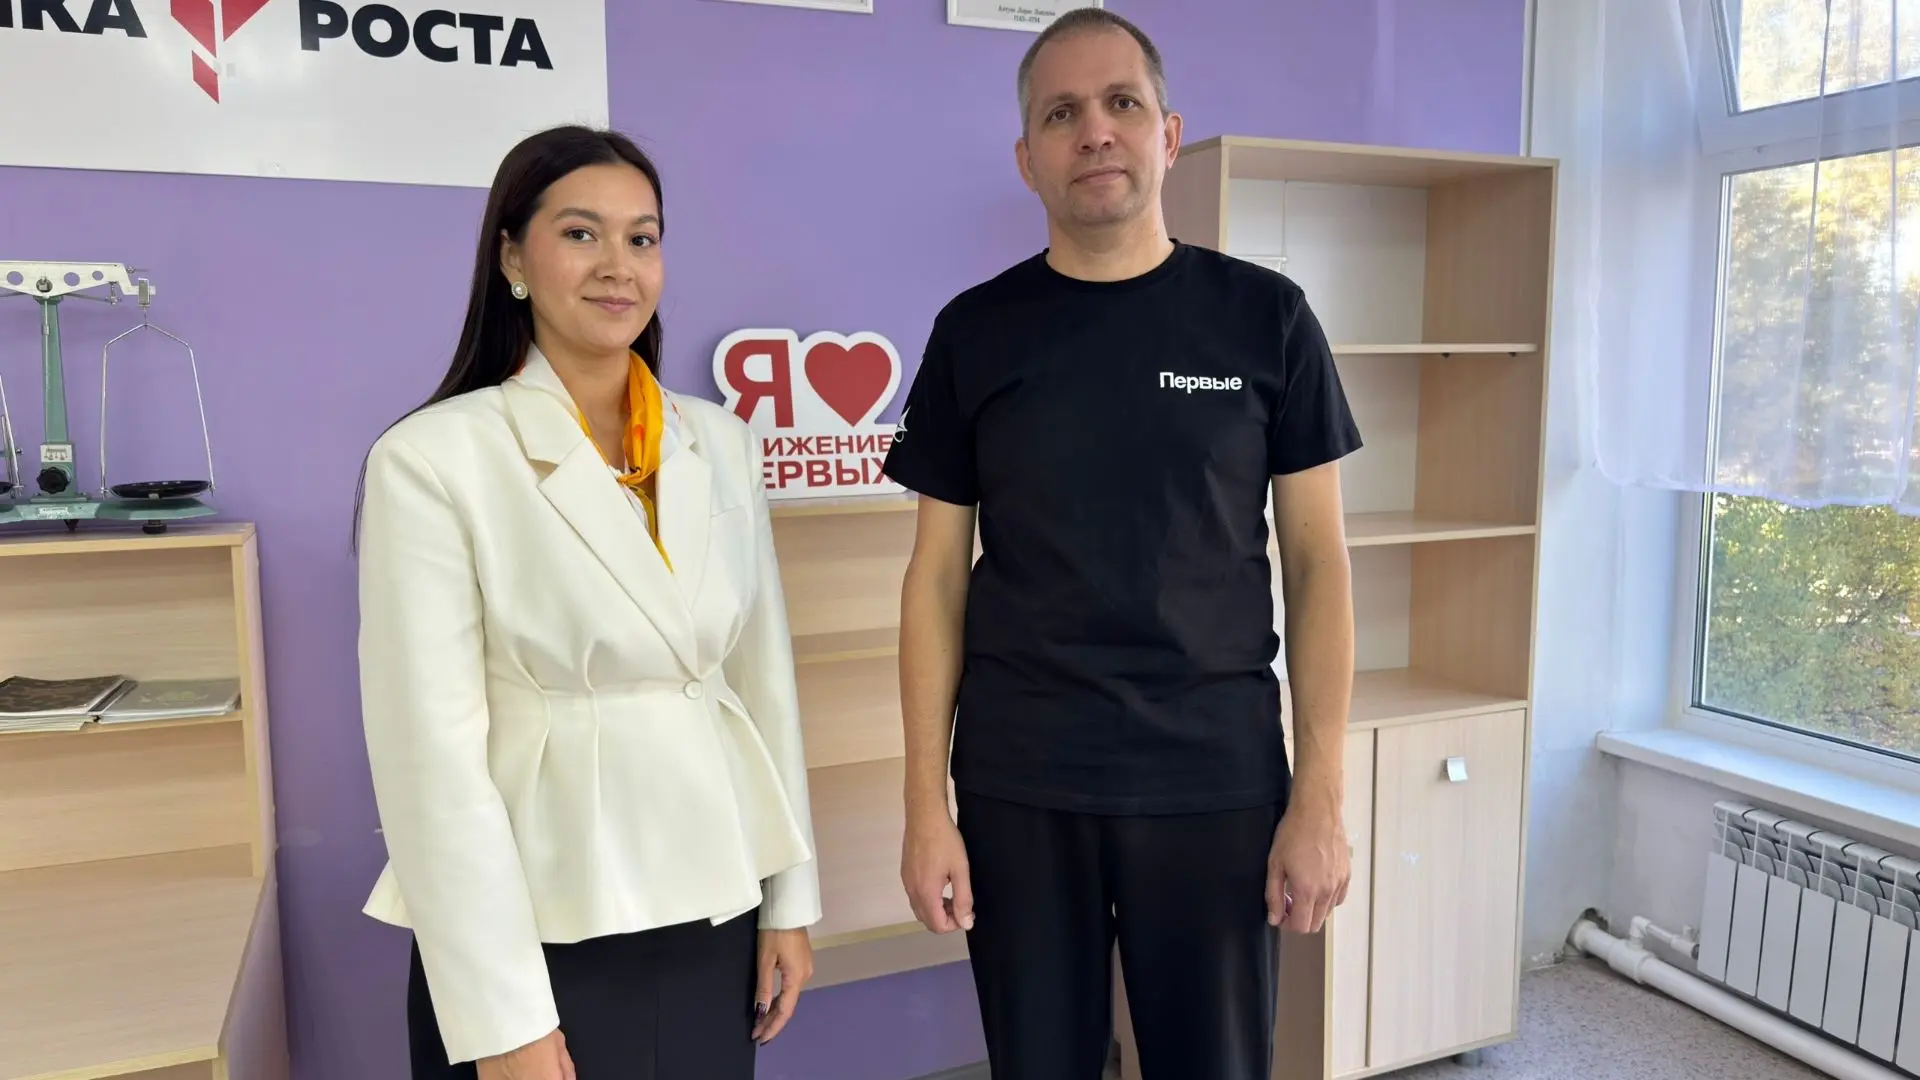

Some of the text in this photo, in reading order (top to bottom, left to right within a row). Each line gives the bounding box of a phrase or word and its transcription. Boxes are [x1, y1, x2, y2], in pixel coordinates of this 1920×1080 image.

[0, 0, 554, 70] КА РОСТА
[724, 339, 794, 428] Я
[1159, 371, 1243, 394] Первые
[763, 434, 894, 457] ИЖЕНИЕ
[763, 457, 896, 489] ЕРВЫХ
